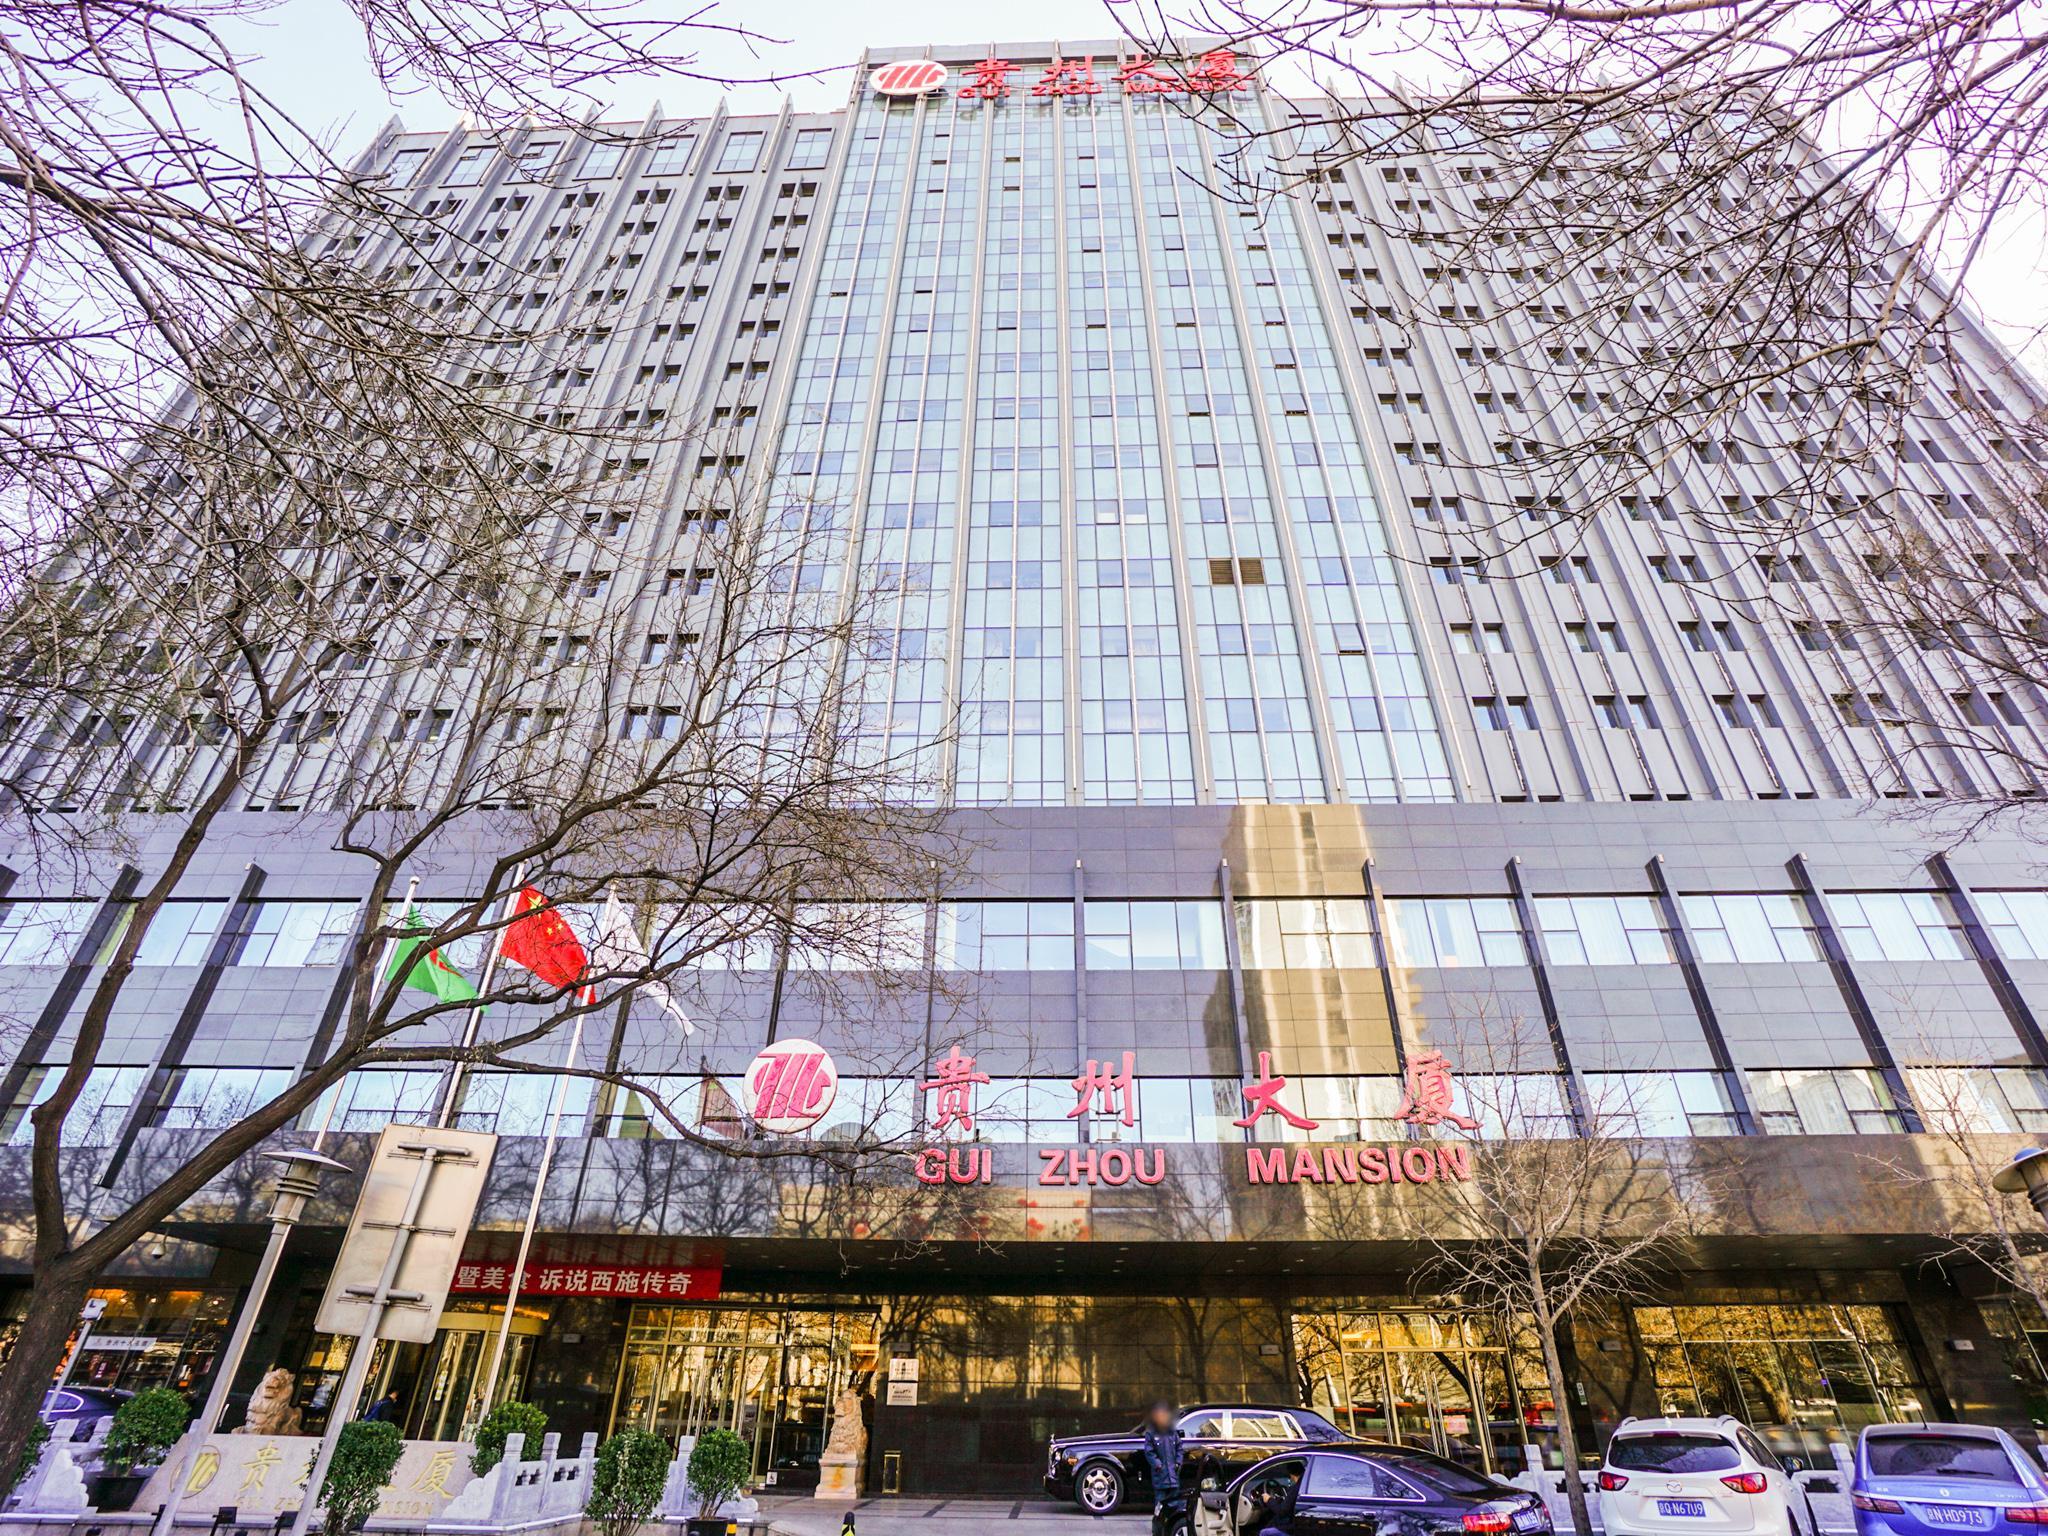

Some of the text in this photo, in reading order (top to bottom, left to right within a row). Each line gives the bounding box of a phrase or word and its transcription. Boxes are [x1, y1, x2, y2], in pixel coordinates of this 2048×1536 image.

[961, 51, 1256, 88] 贵州大厦
[957, 80, 1248, 98] GUI ZHOU MANSION
[919, 1045, 1484, 1131] 贵州大厦
[914, 1146, 1472, 1185] GUI ZHOU MANSION
[539, 1268, 692, 1295] 诉说西施传奇
